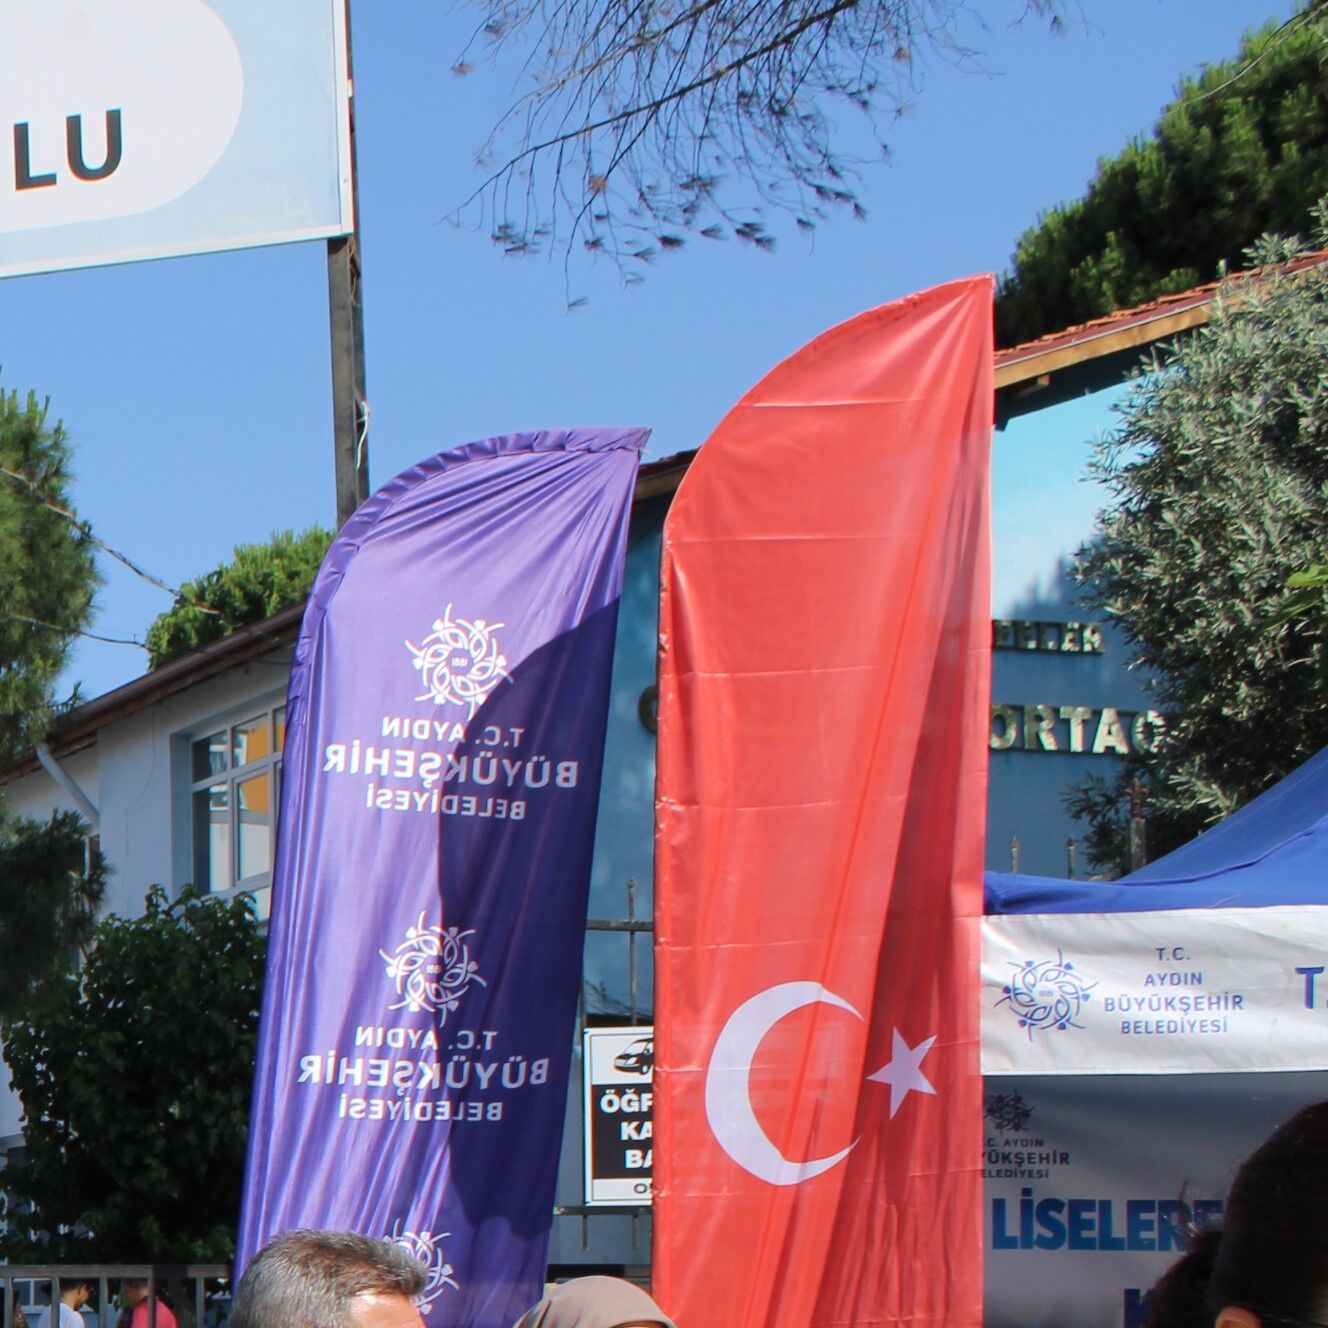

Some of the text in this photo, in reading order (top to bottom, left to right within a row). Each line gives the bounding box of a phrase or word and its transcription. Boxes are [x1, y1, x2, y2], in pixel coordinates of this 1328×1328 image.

[1156, 947, 1191, 962] T.C.
[1144, 971, 1203, 988] AYDIN
[1295, 966, 1328, 1010] T
[1103, 994, 1245, 1015] BÜYÜKŞEHİR
[1121, 1016, 1229, 1035] BELEDİYESİ
[1004, 1138, 1045, 1148] AYDIN
